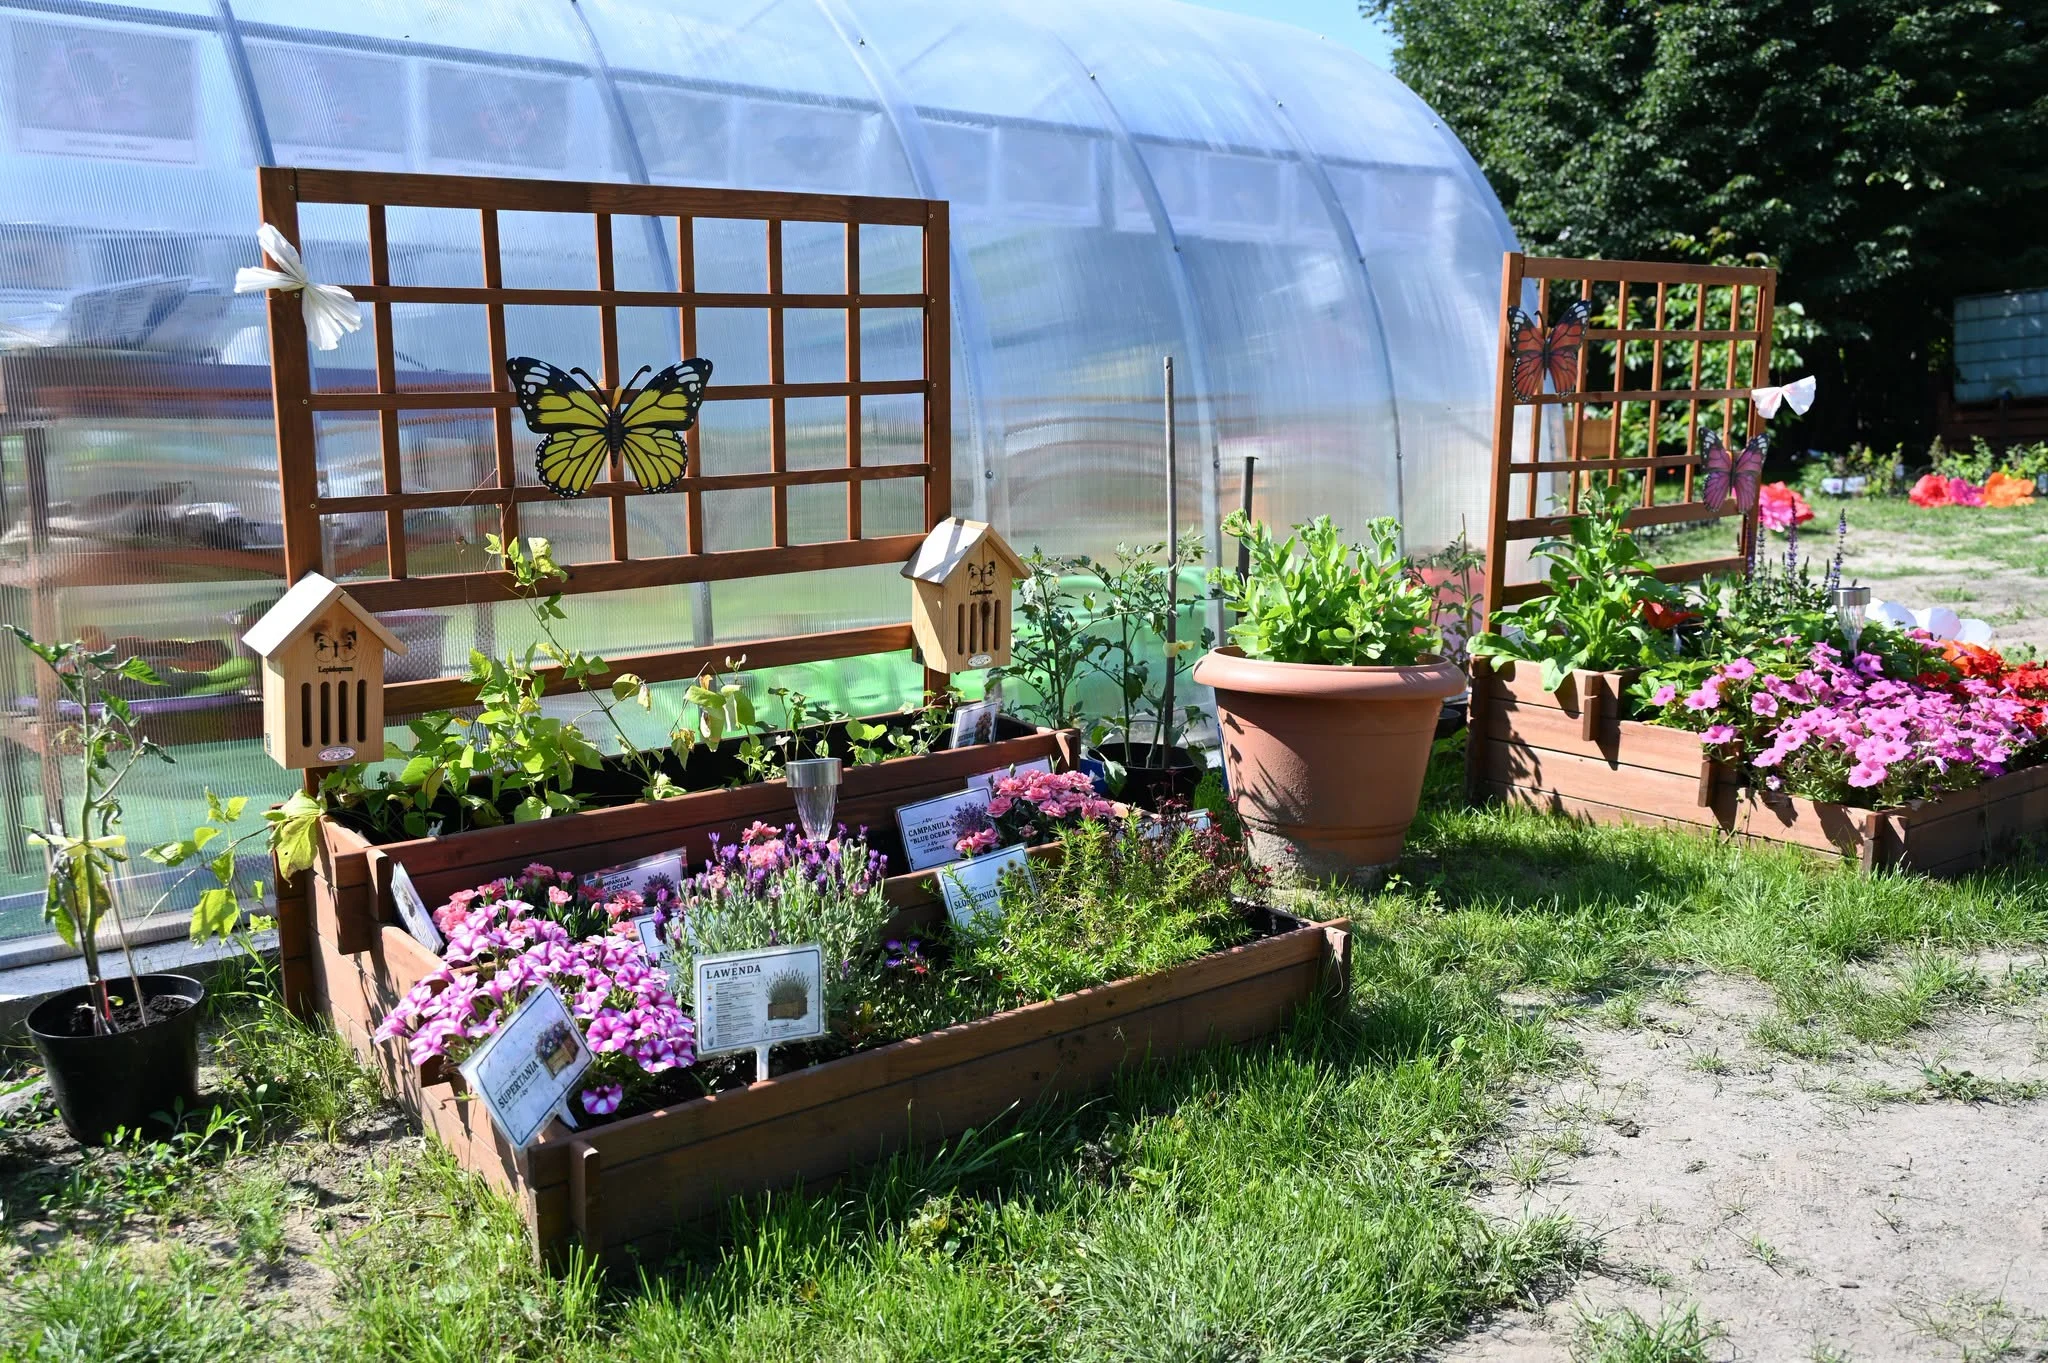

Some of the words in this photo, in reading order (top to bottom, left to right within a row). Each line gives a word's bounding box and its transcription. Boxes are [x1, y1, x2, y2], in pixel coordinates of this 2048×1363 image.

[908, 820, 951, 837] CAMPANULA
[706, 964, 761, 979] LAWENDA
[497, 1060, 540, 1109] SUPERTANIA
